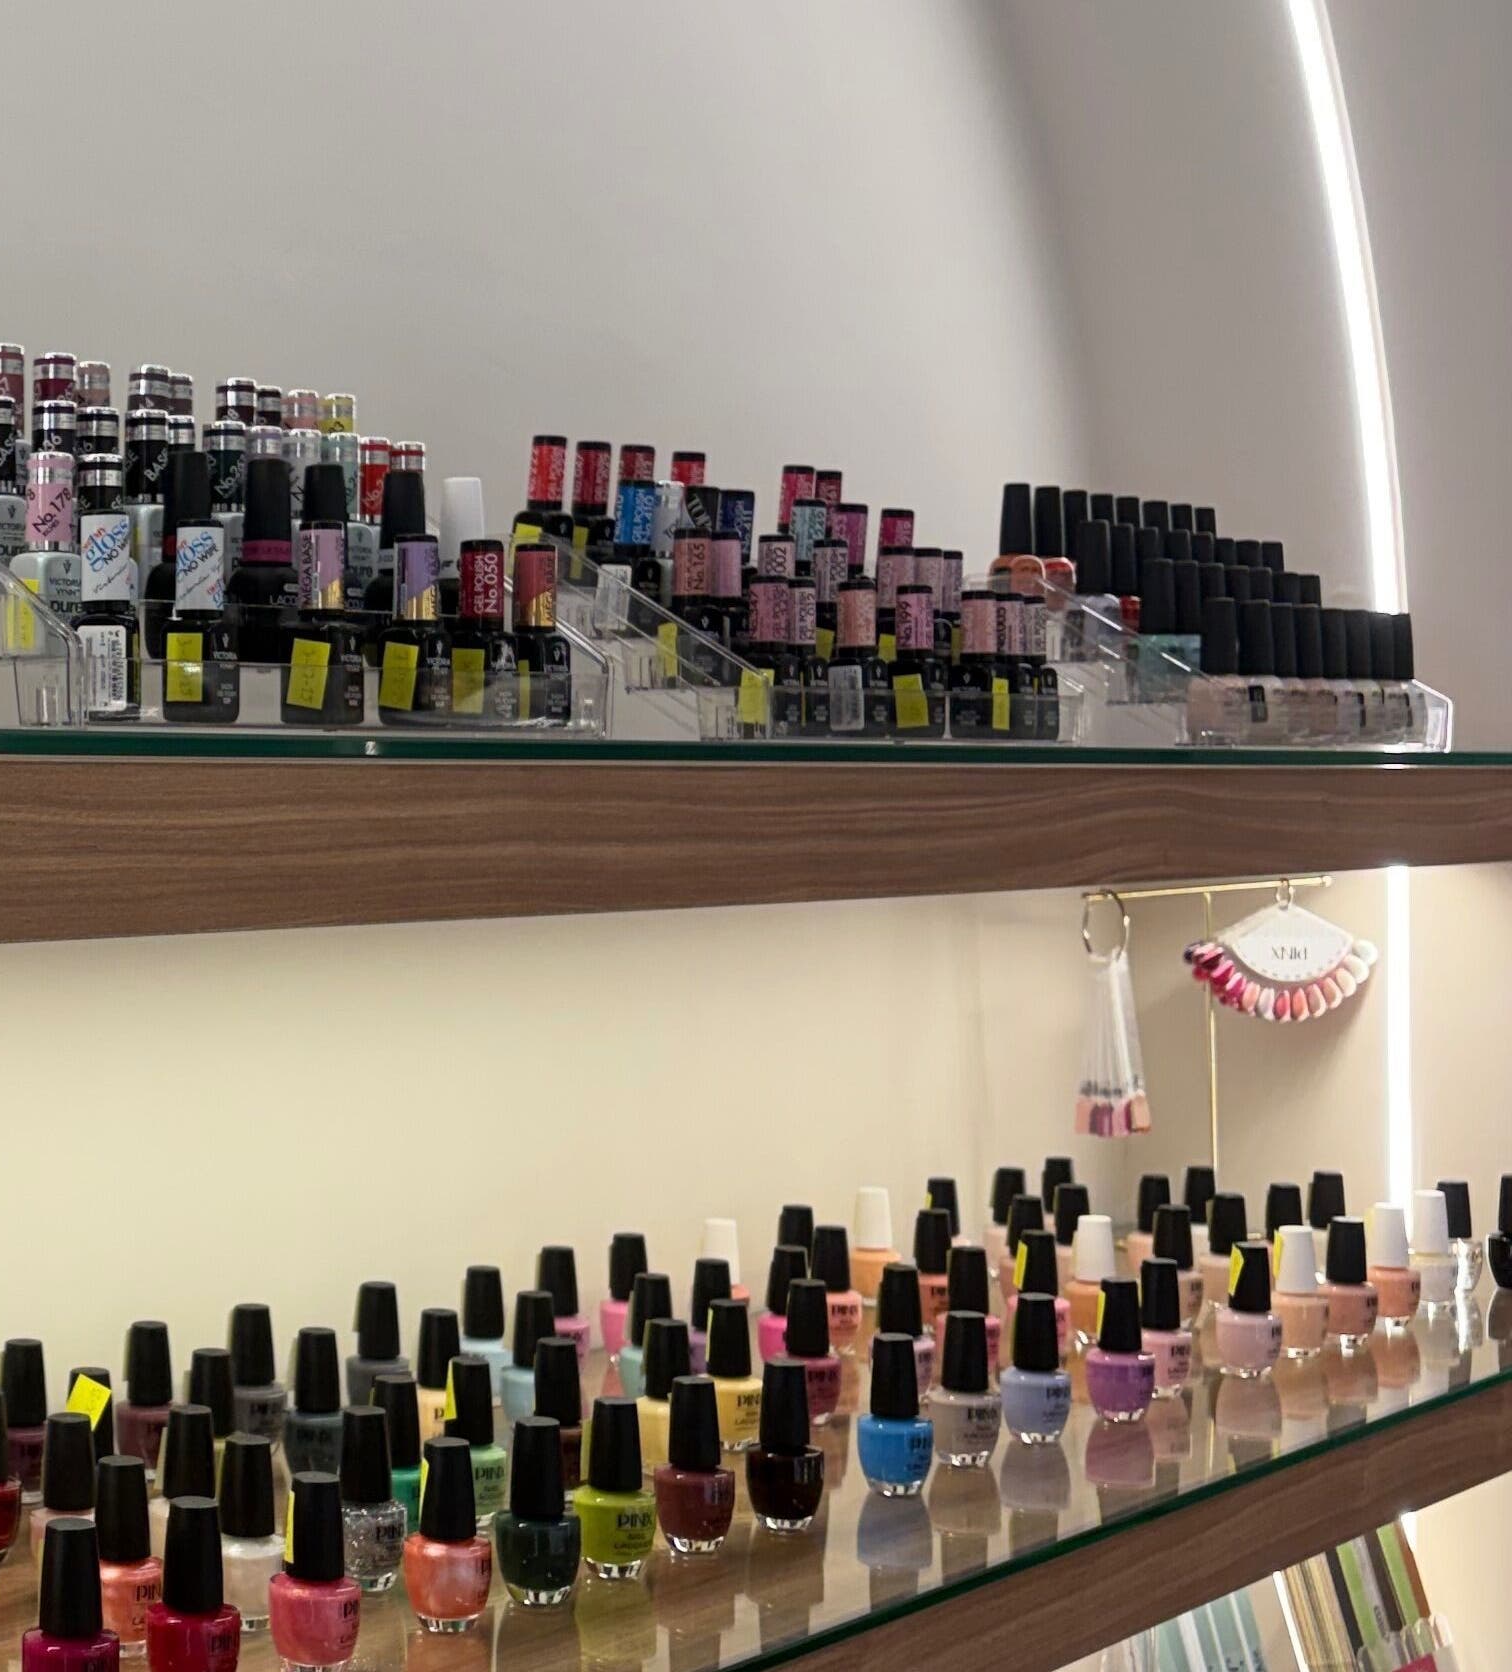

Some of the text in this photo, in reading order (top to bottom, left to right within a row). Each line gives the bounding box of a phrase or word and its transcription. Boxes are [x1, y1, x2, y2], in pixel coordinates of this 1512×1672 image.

[32, 487, 72, 534] No.178
[302, 566, 312, 606] MEGA
[484, 554, 498, 613] No.050
[693, 544, 706, 590] No.165
[136, 1584, 161, 1602] PIN
